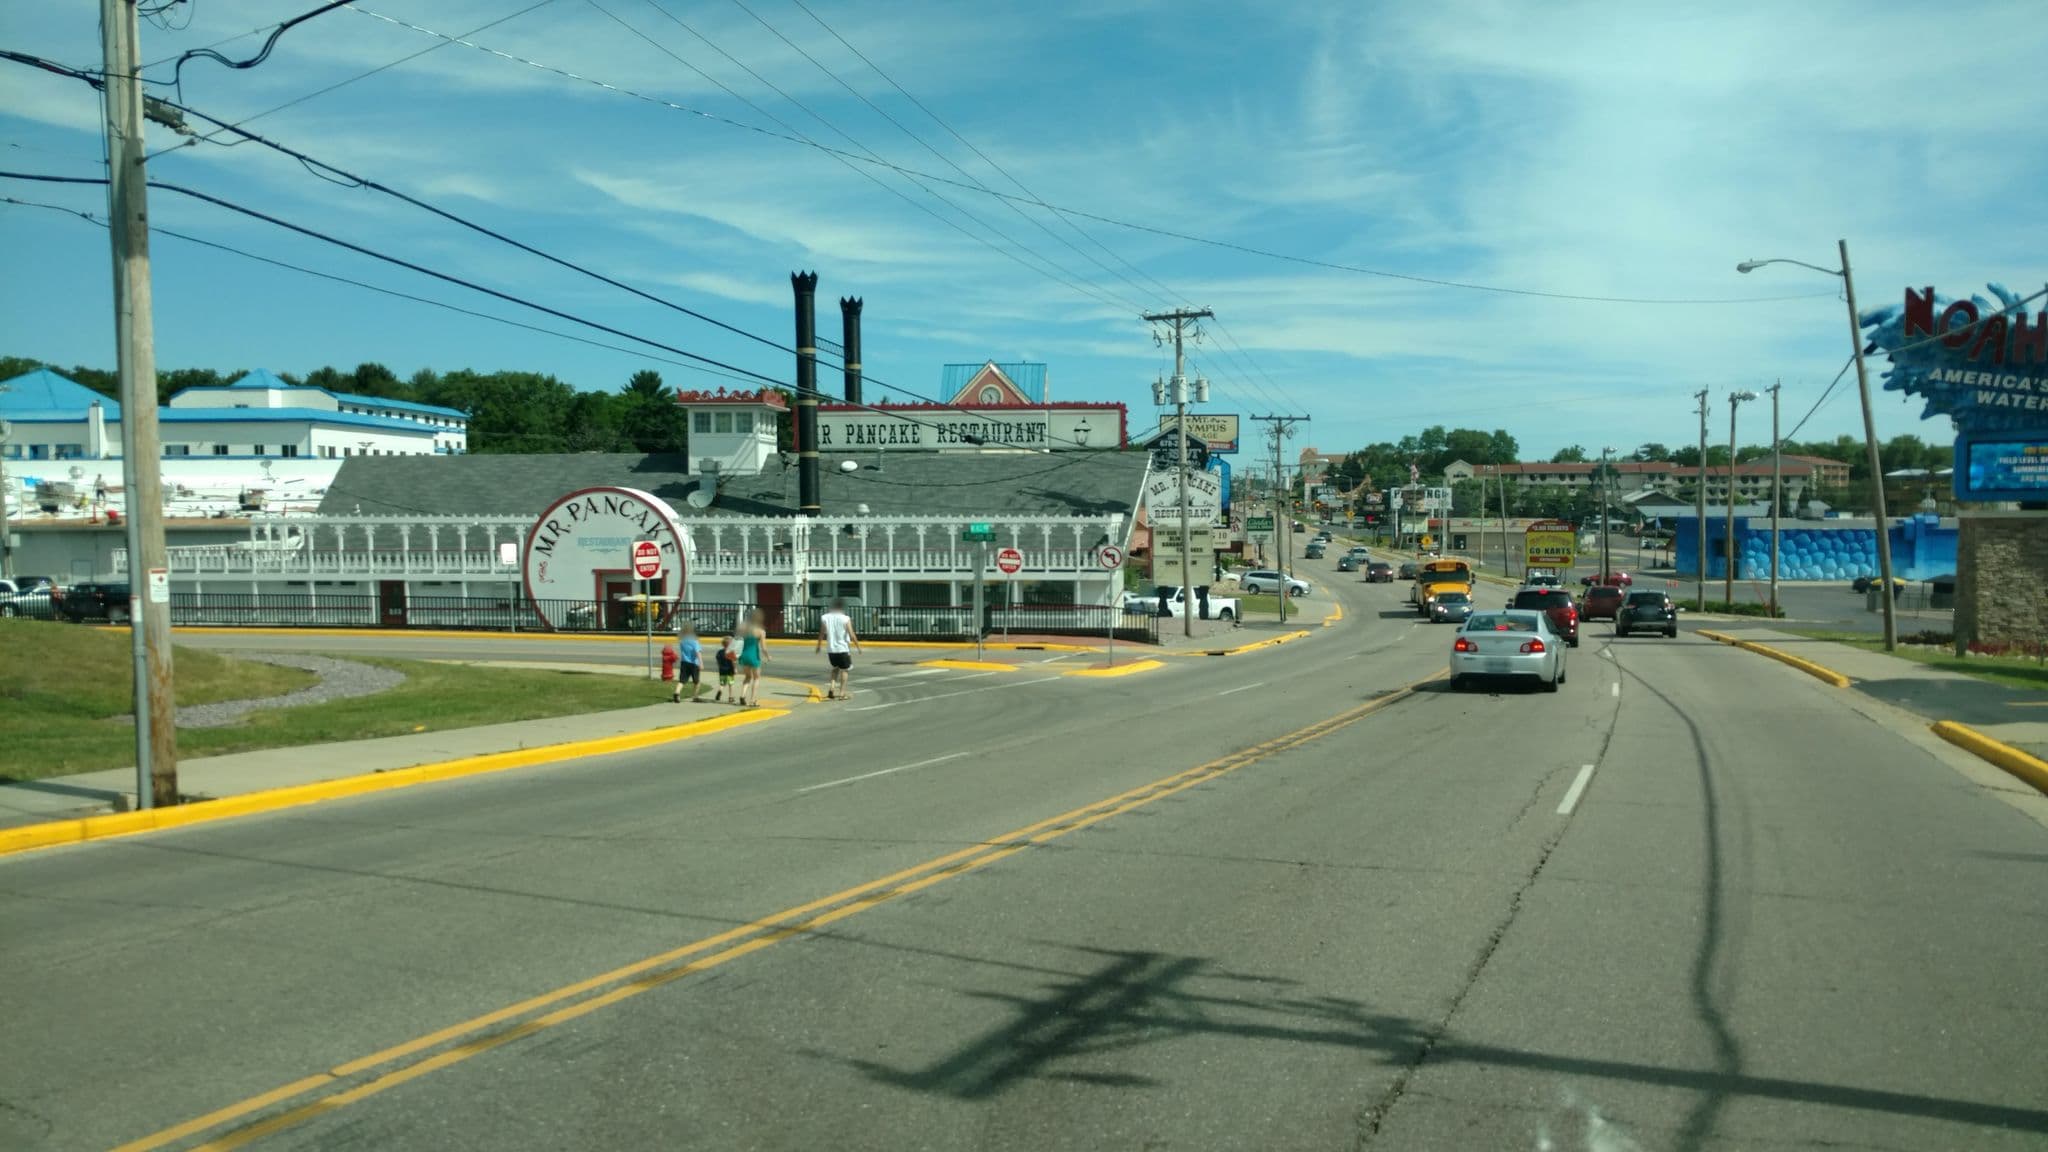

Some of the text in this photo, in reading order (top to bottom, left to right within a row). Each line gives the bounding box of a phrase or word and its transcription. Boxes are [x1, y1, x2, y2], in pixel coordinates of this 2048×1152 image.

[845, 423, 921, 445] PANCAKE
[936, 422, 1047, 444] RESTAURANT
[1154, 509, 1212, 518] RESTARANT
[535, 495, 675, 558] MR. PANCAKE
